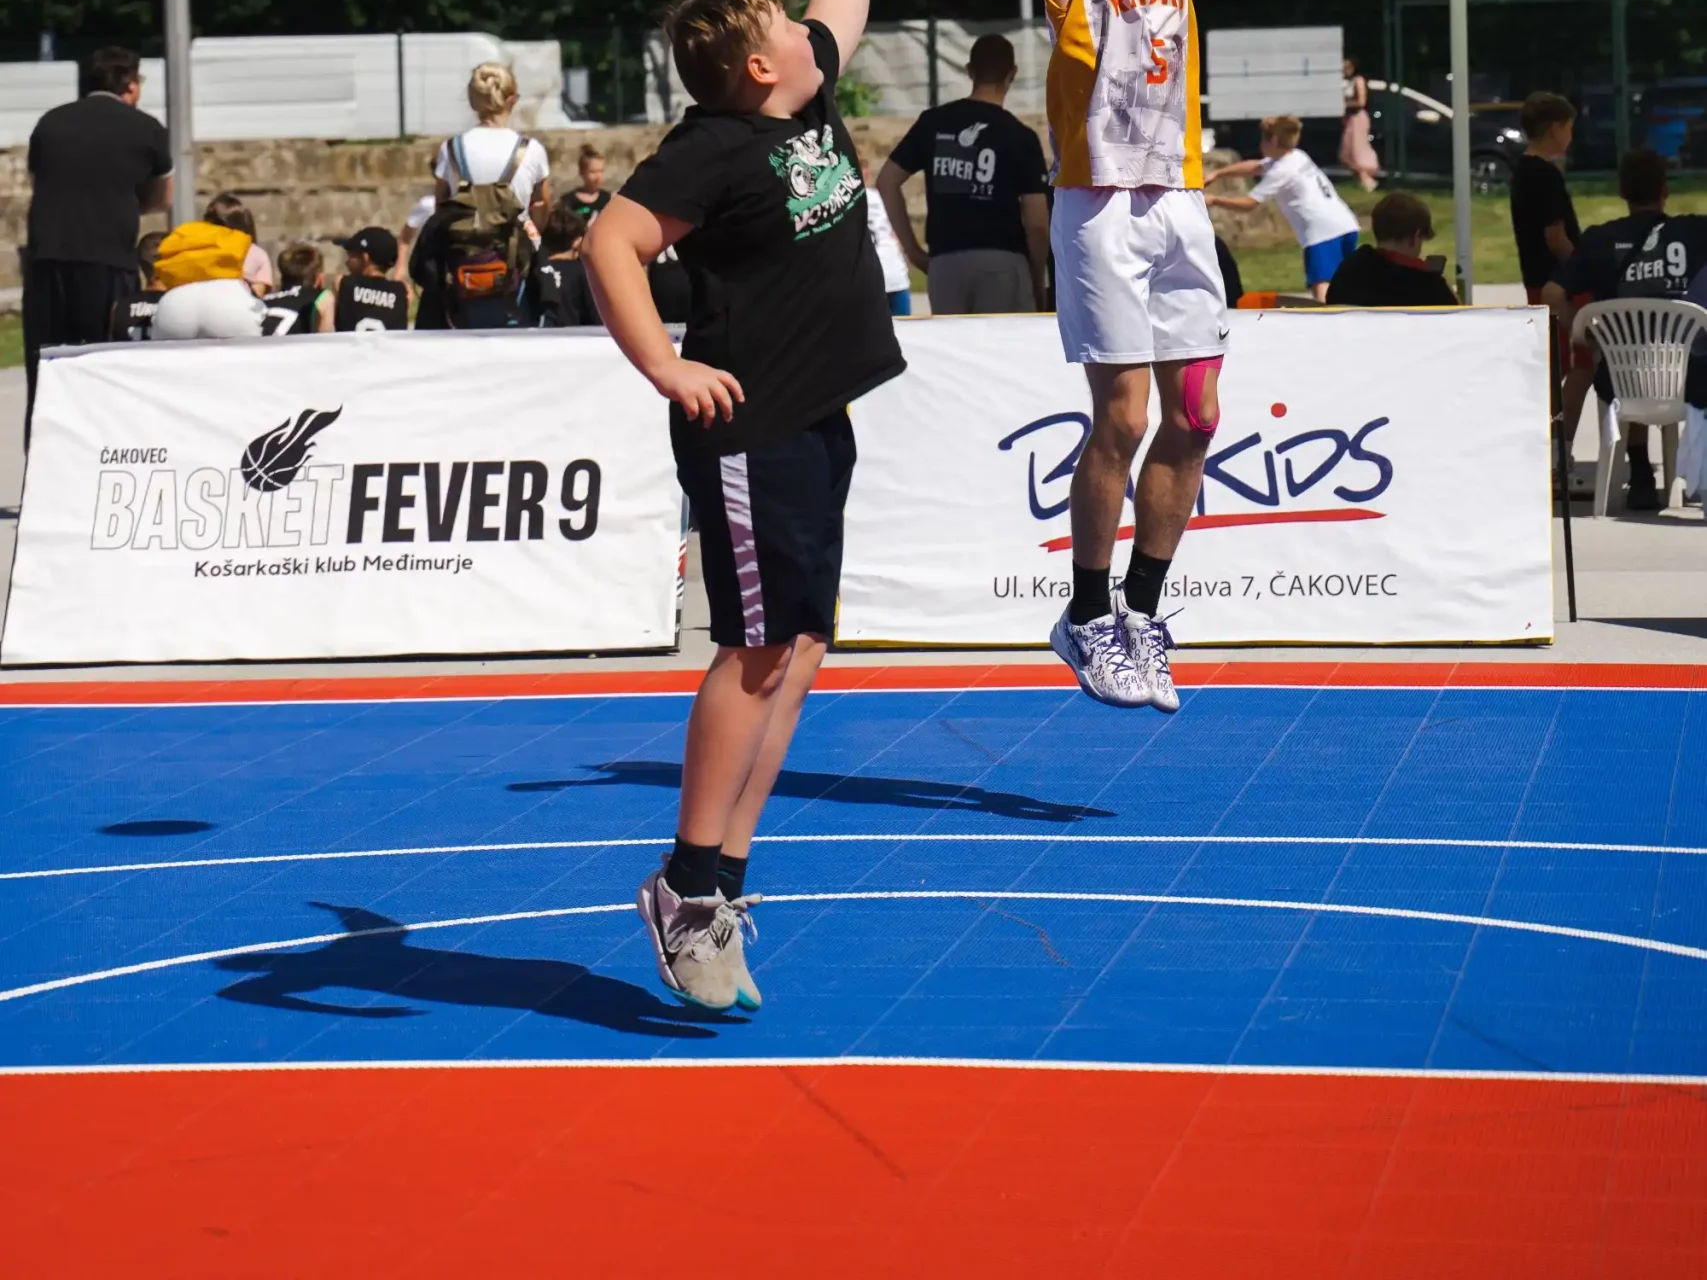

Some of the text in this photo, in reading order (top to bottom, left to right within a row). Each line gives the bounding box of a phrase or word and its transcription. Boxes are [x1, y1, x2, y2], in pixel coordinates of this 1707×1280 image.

[1146, 38, 1168, 85] 5
[933, 148, 996, 183] FEVER 9
[1666, 241, 1687, 277] 9
[100, 446, 168, 464] ČAKOVEC
[90, 459, 602, 550] BASKET FEVER 9
[194, 553, 473, 577] Košarkaški klub Međimurje
[993, 576, 1024, 598] Ul.
[1032, 576, 1073, 598] Kra
[1241, 576, 1261, 601] 7,
[1269, 570, 1397, 597] ČAKOVEC
